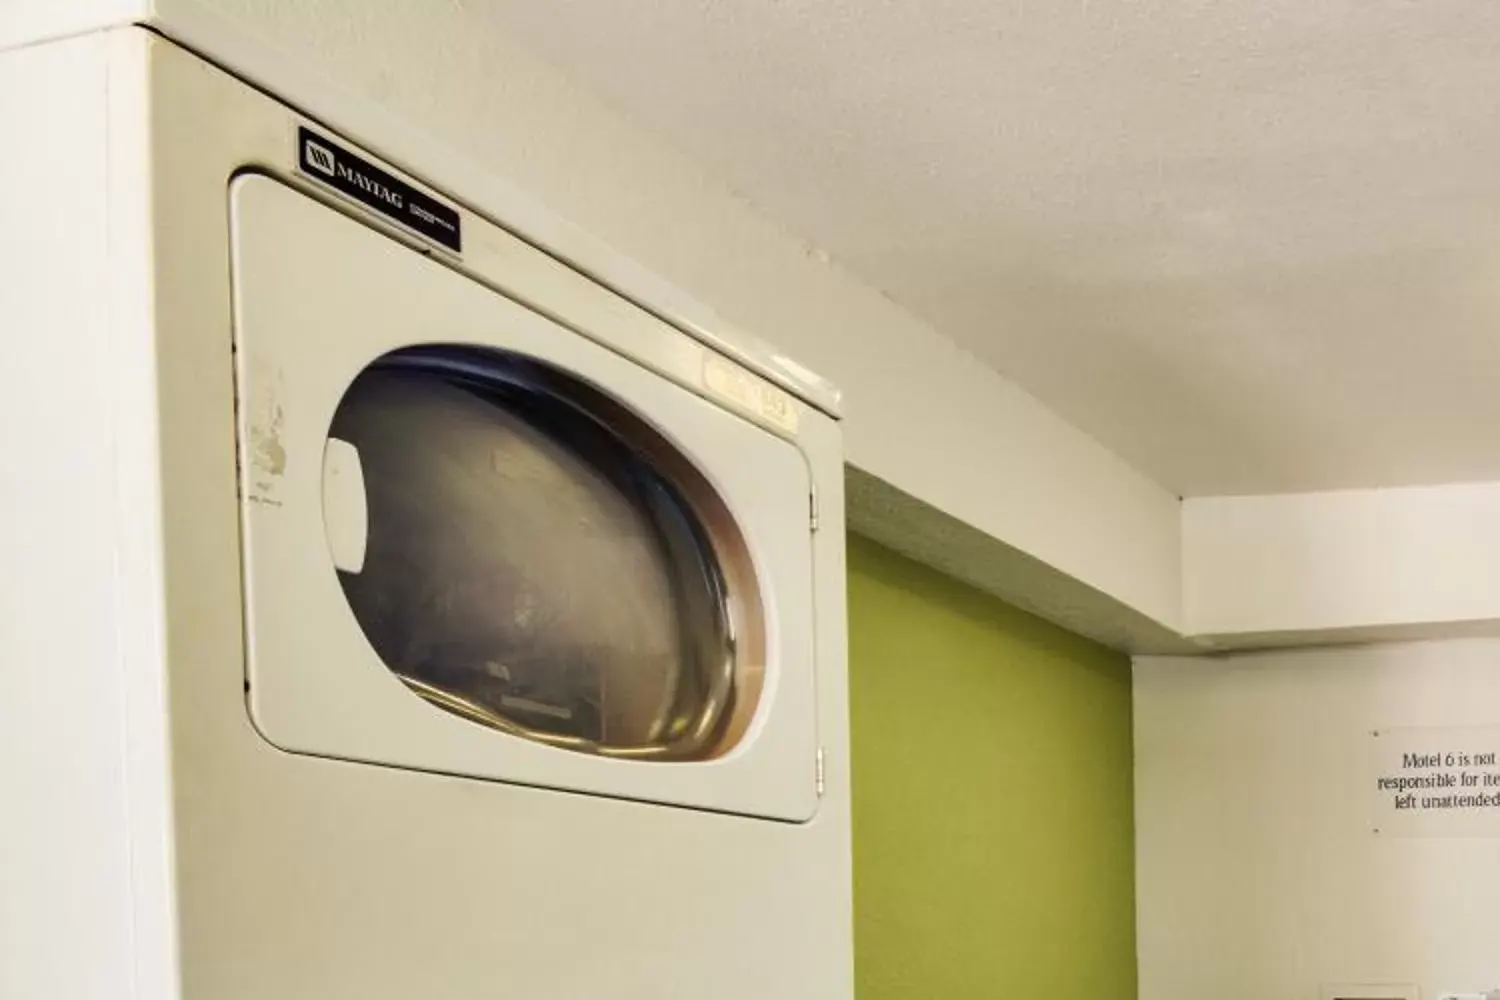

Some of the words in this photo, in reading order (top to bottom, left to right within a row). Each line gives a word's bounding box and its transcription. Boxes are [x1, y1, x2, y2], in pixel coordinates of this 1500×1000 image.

[337, 163, 403, 209] MAYTAG
[1402, 753, 1441, 769] Motel
[1445, 753, 1455, 767] 6
[1459, 752, 1471, 766] is
[1474, 752, 1496, 766] not
[1377, 772, 1456, 791] responsible
[1460, 771, 1478, 787] for
[1395, 795, 1417, 809] left
